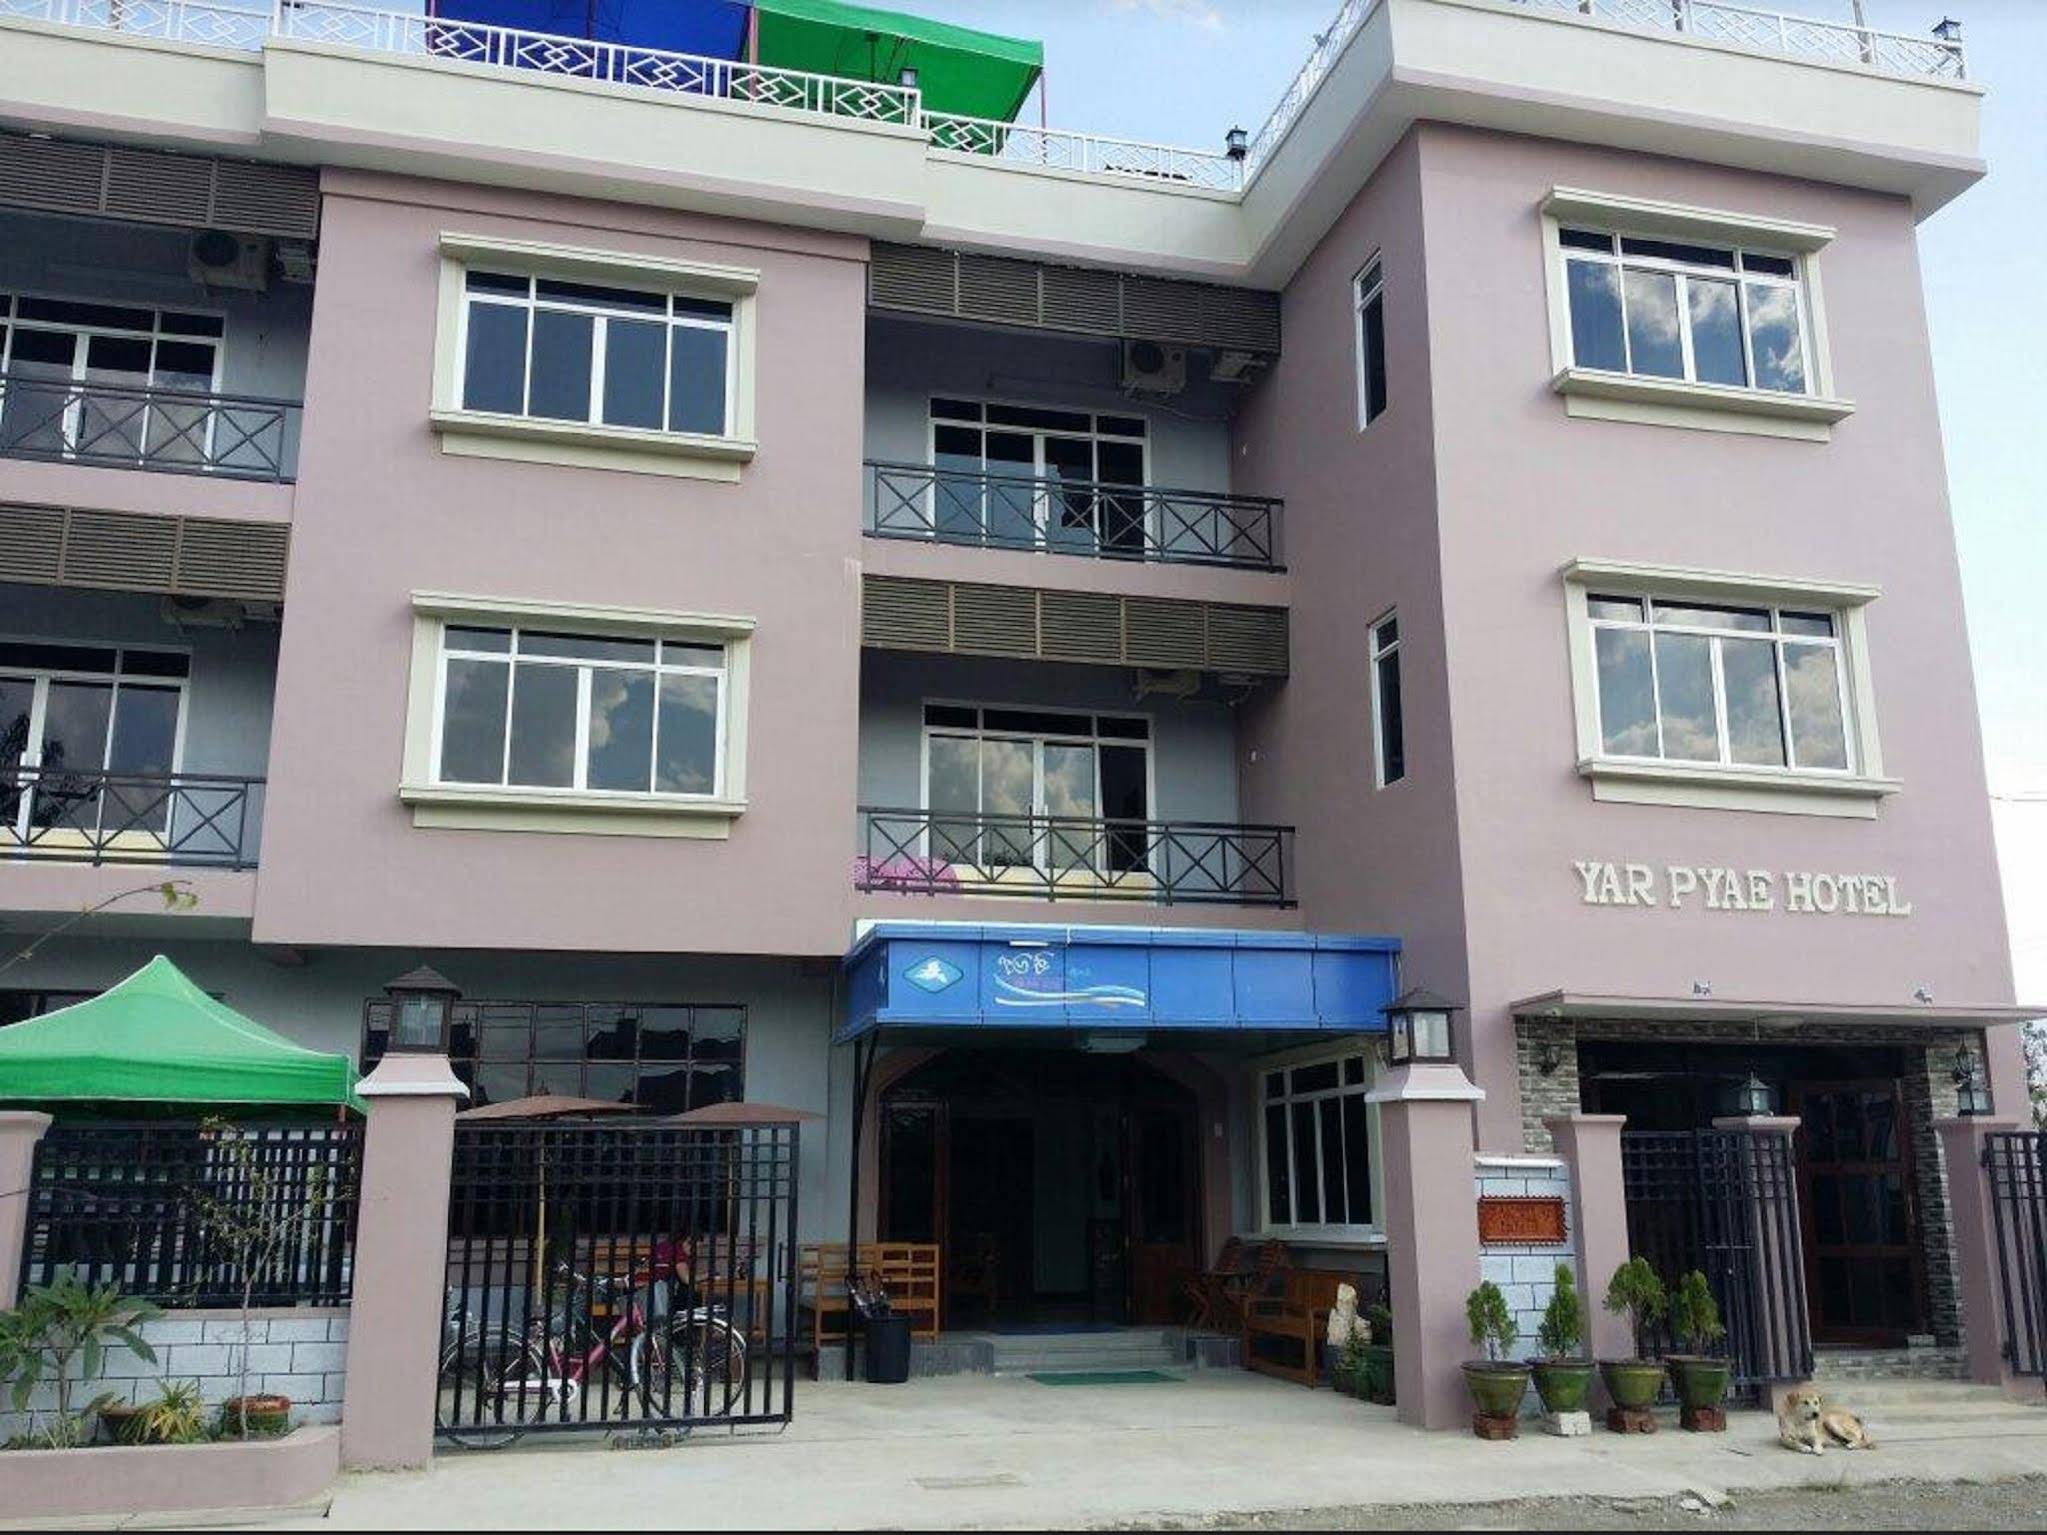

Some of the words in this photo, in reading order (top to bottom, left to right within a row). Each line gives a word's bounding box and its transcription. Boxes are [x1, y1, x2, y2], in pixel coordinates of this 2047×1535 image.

[1575, 861, 1656, 905] YAR
[1667, 866, 1775, 910] PYAE
[1784, 871, 1912, 915] HOTEL
